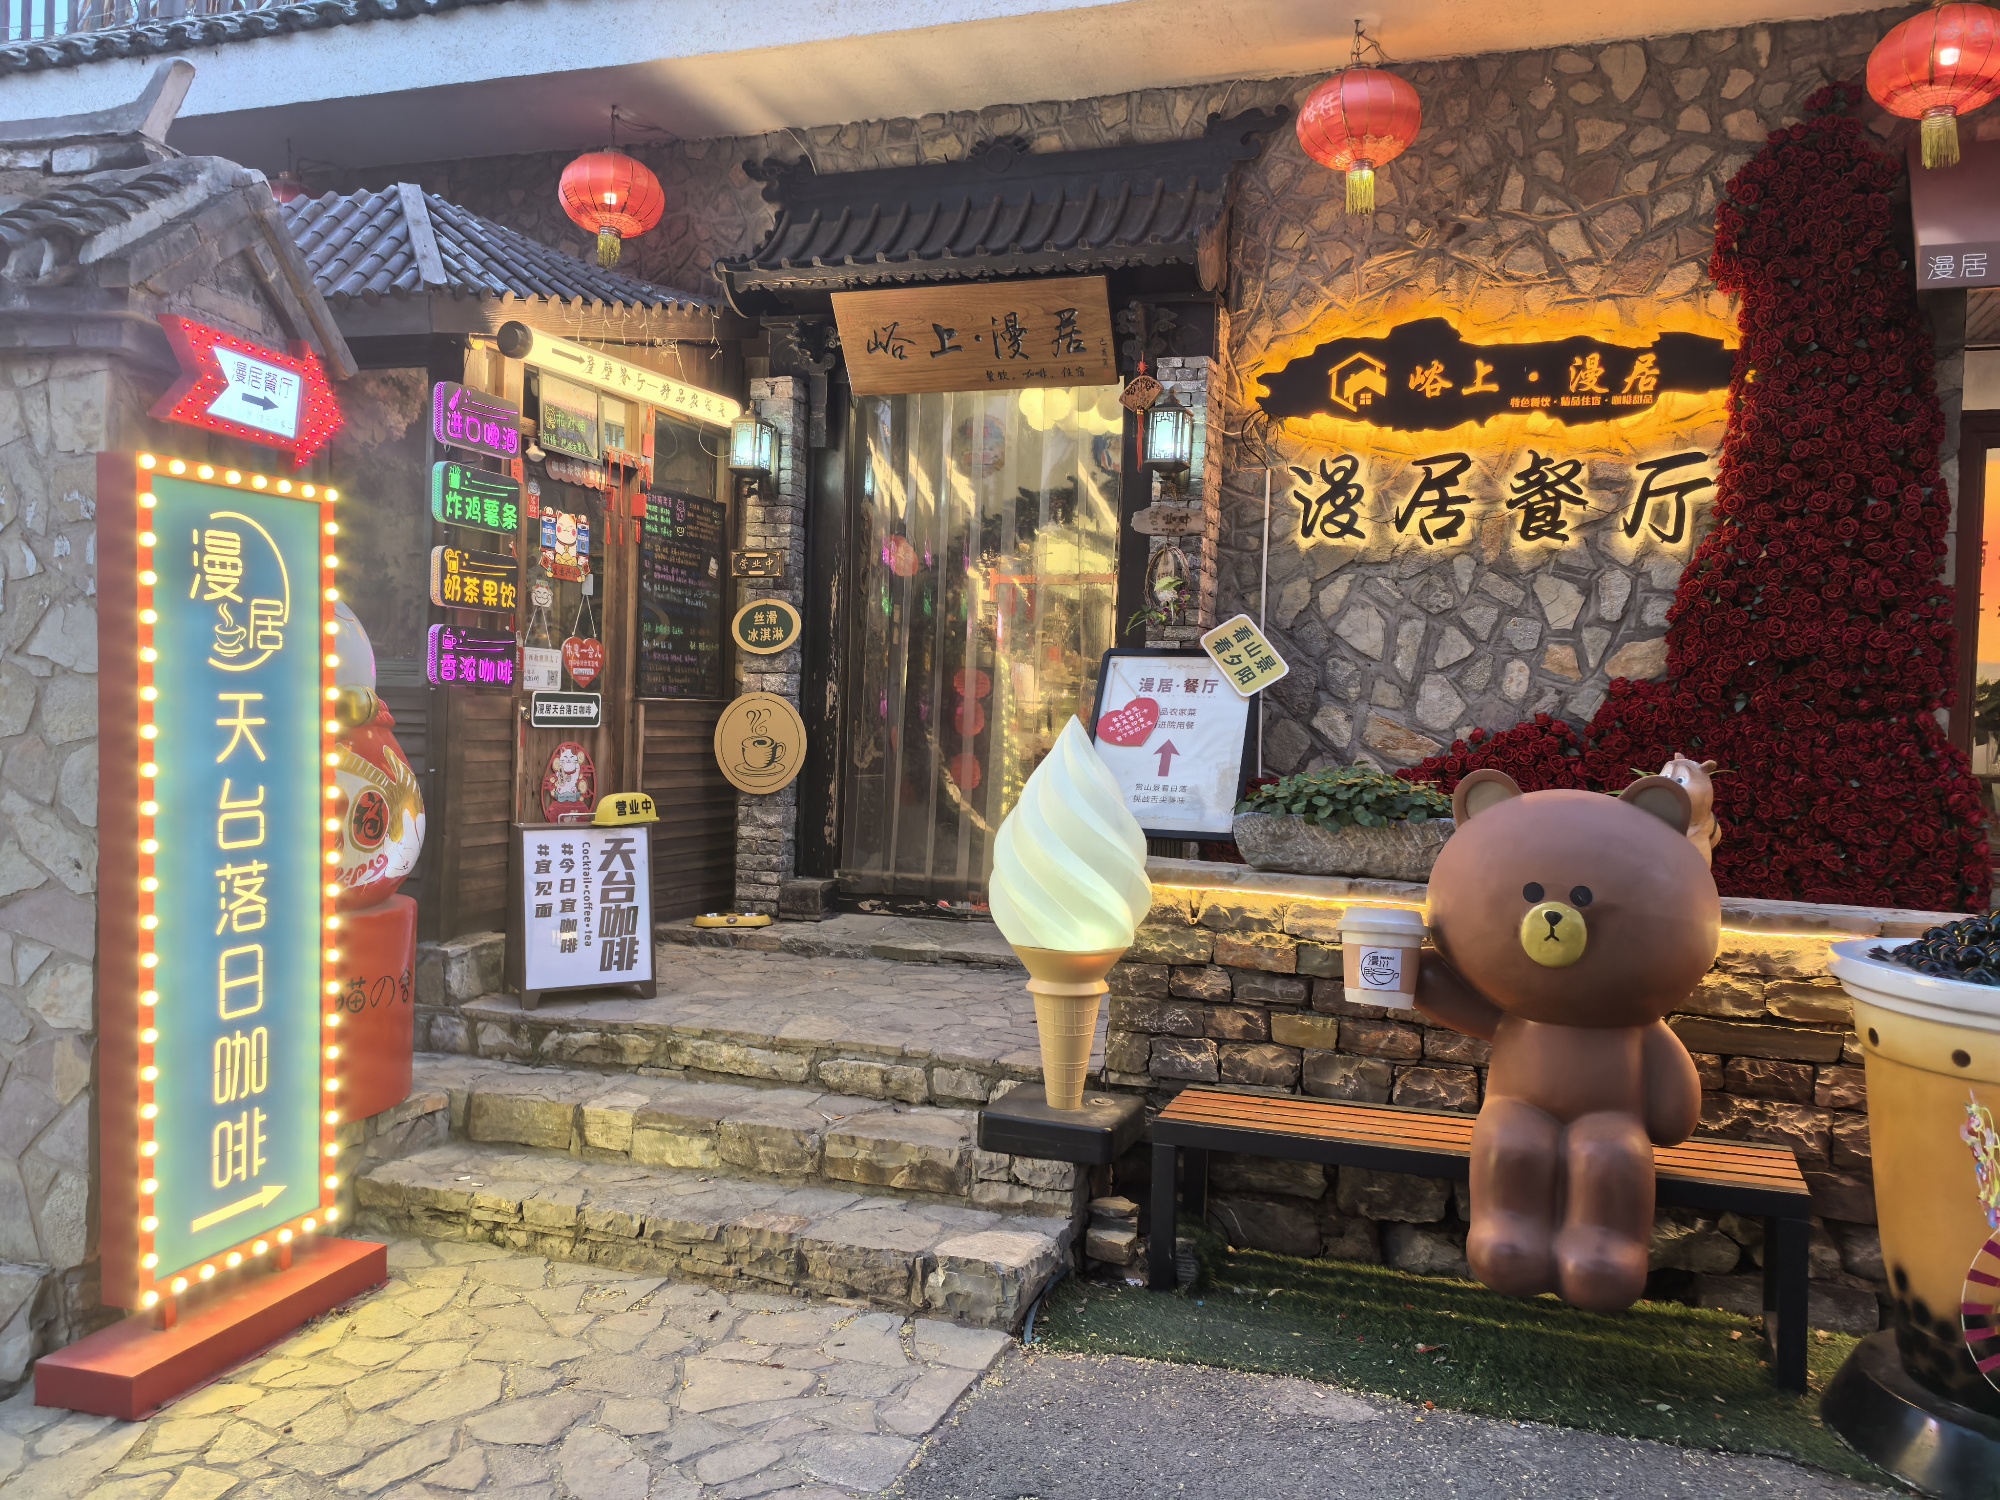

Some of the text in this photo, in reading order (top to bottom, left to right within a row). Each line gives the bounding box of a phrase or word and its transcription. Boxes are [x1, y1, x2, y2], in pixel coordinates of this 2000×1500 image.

[1928, 253, 1987, 279] 漫居
[232, 361, 292, 399] 漫居餐厅
[1408, 352, 1660, 399] 峪上·漫居
[447, 410, 518, 453] 进口啤酒
[445, 491, 518, 530] 炸鸡薯条
[1290, 448, 1716, 545] 漫居餐厅
[739, 557, 775, 570] 营业中
[444, 575, 516, 608] 奶茶果饮
[747, 626, 784, 642] 冰淇淋
[754, 610, 778, 625] 丝滑
[1213, 636, 1257, 686] 看夕阳
[1232, 625, 1276, 673] 看山景
[440, 653, 513, 685] 香浓咖啡
[1139, 677, 1219, 694] 漫居·餐厅
[537, 703, 592, 715] 漫居天台落日咖啡
[615, 798, 652, 816] 营业中
[534, 843, 553, 918] #宜见面
[597, 837, 639, 972] 天台咖啡
[212, 692, 267, 1189] 天台落日咖啡
